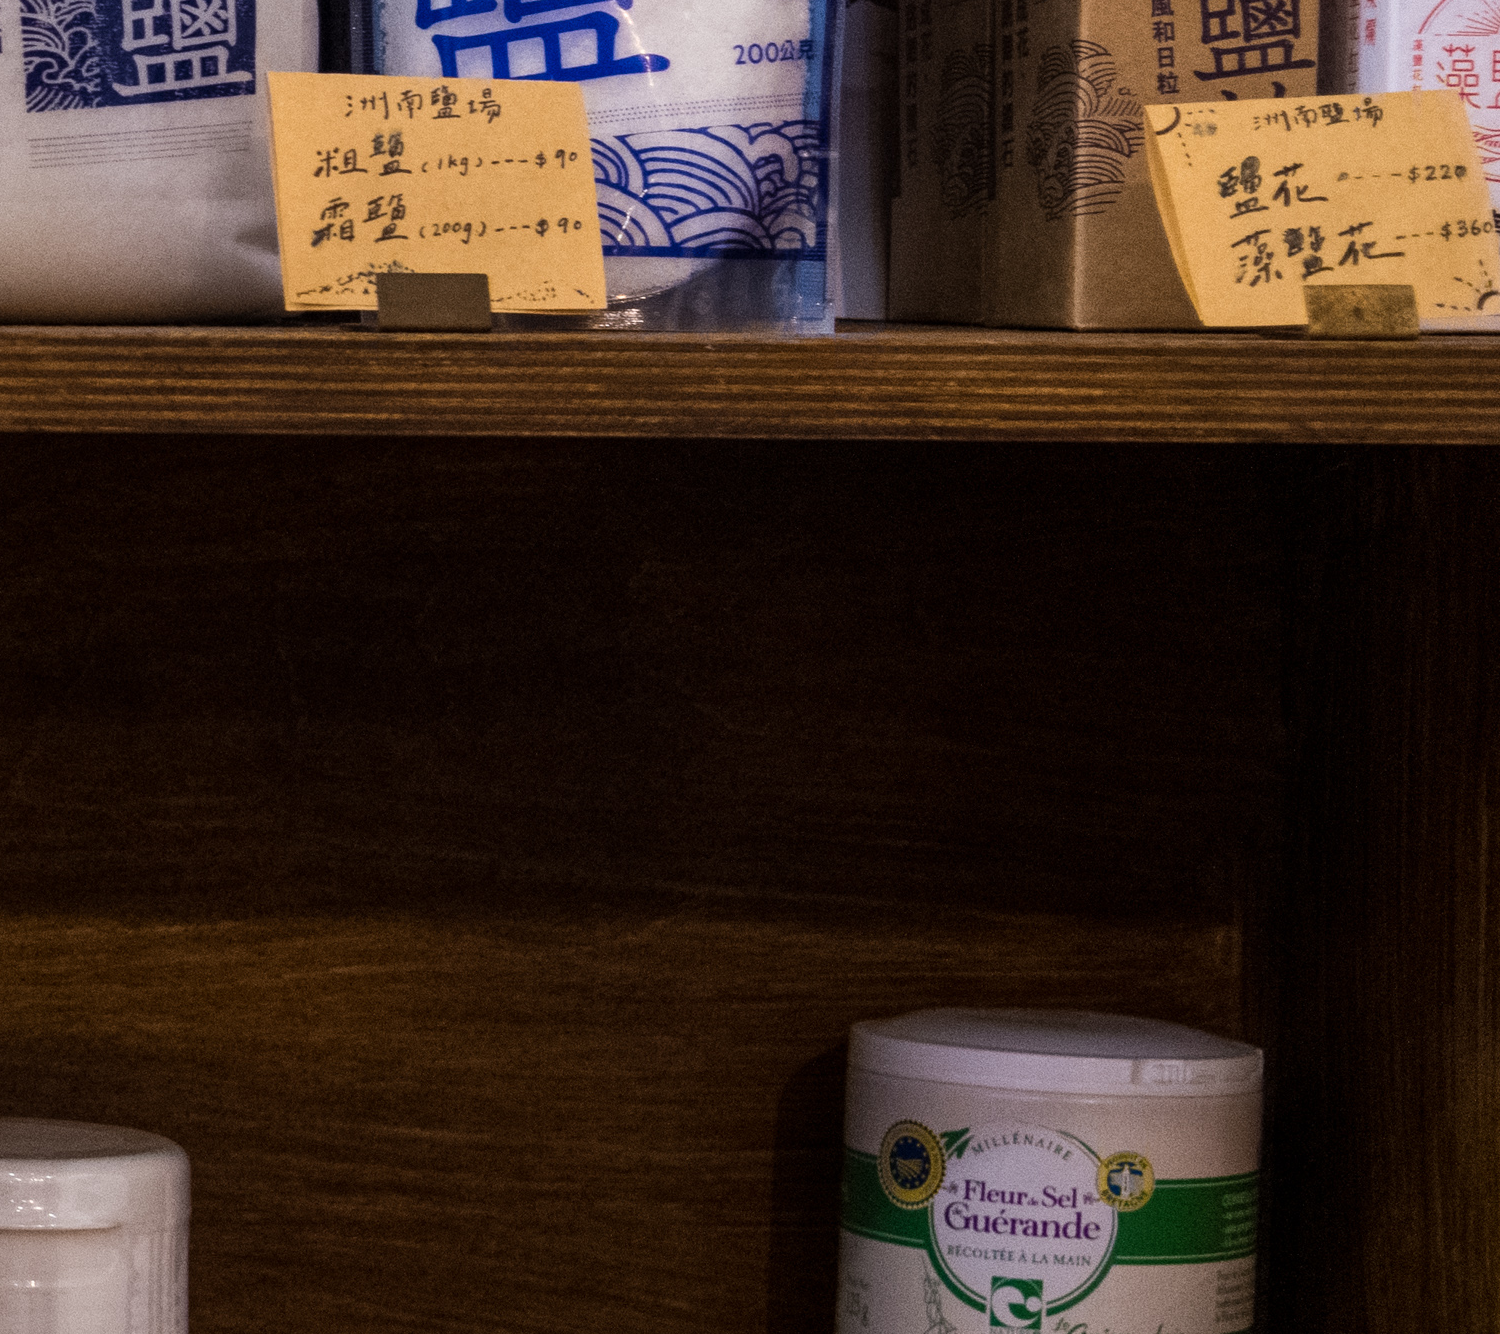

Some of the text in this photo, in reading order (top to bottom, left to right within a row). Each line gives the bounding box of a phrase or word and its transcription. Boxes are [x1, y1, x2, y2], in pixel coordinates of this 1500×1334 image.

[733, 39, 815, 67] 200公克
[344, 84, 502, 125] 洲南鹽場
[1253, 96, 1384, 131] 洲南鹽場
[971, 1132, 1073, 1162] MILLÉNAIRE
[963, 1178, 1078, 1210] Fleur Sel
[944, 1201, 1102, 1242] Guérande
[947, 1243, 1092, 1268] RÉCOLTÉE LA MAIN
